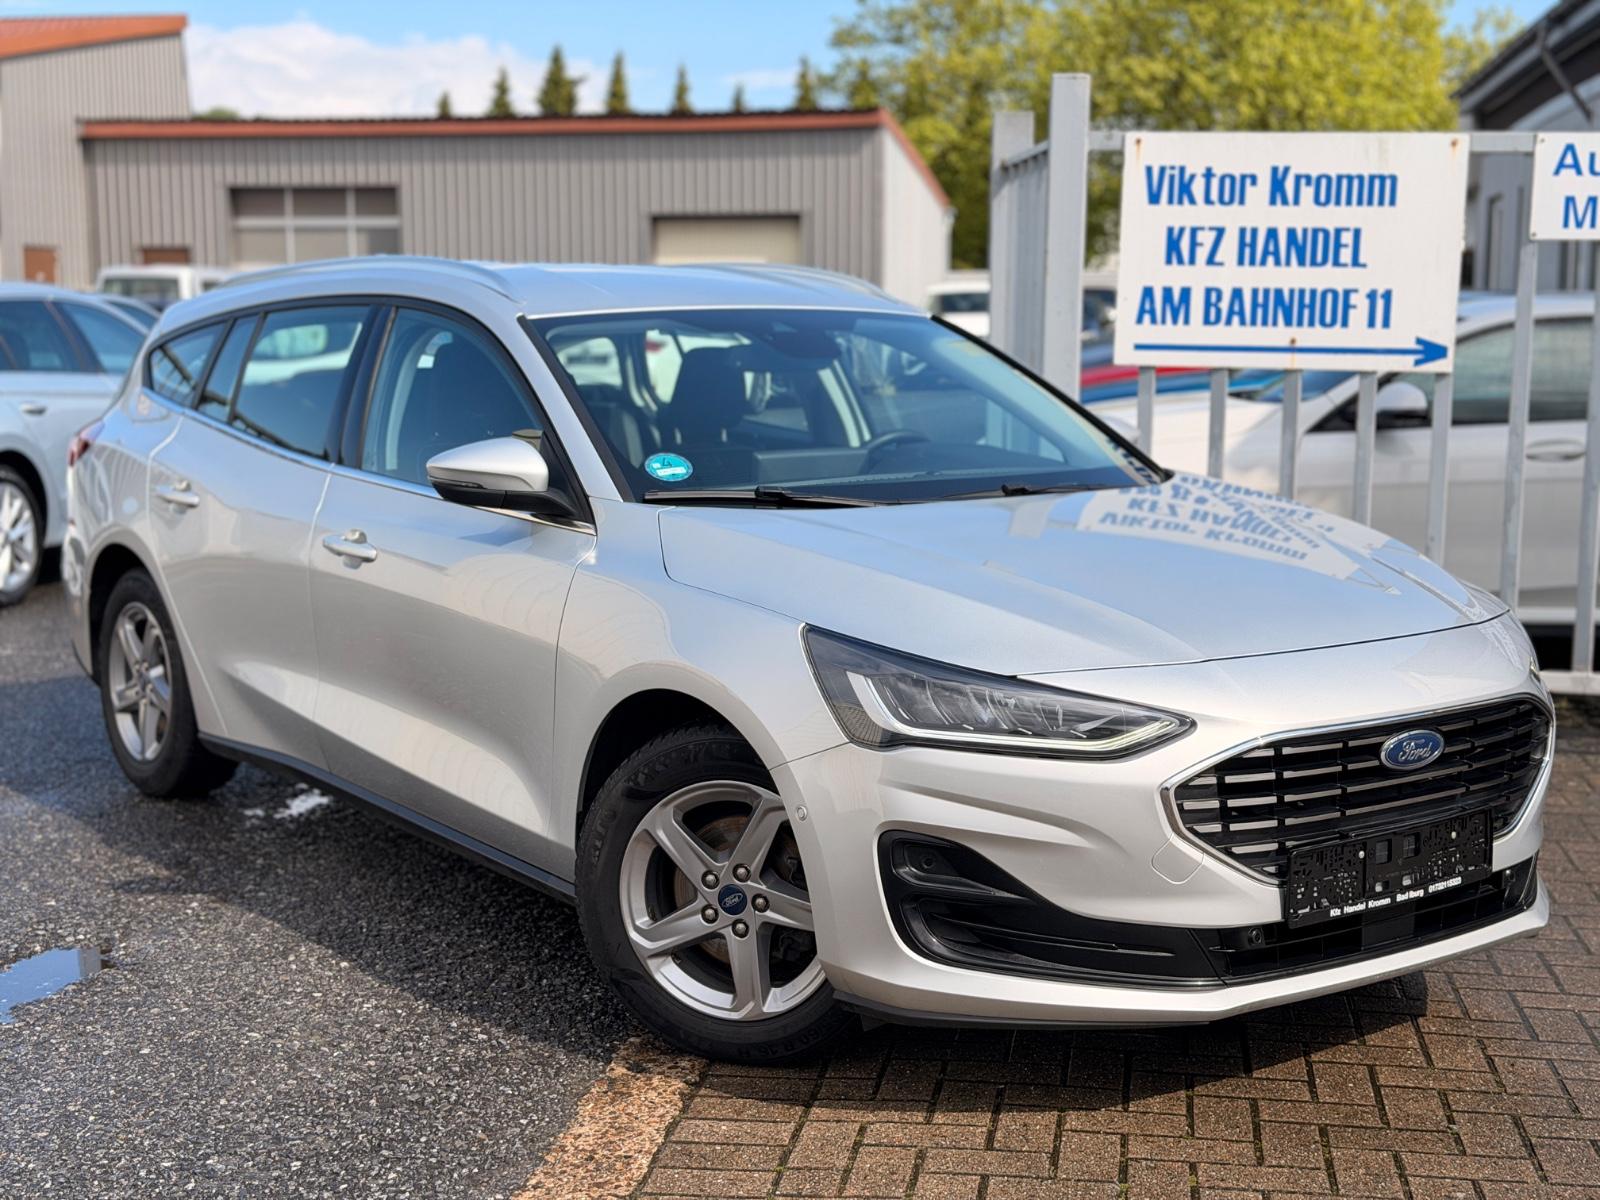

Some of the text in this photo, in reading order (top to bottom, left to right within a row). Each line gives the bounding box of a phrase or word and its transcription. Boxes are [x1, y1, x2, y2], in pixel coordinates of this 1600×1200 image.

[1145, 165, 1398, 208] Viktor Kromm
[1164, 226, 1368, 268] KFZ HANDEL
[1135, 286, 1393, 330] AM BAHNHOF 11
[1399, 739, 1432, 761] Ford
